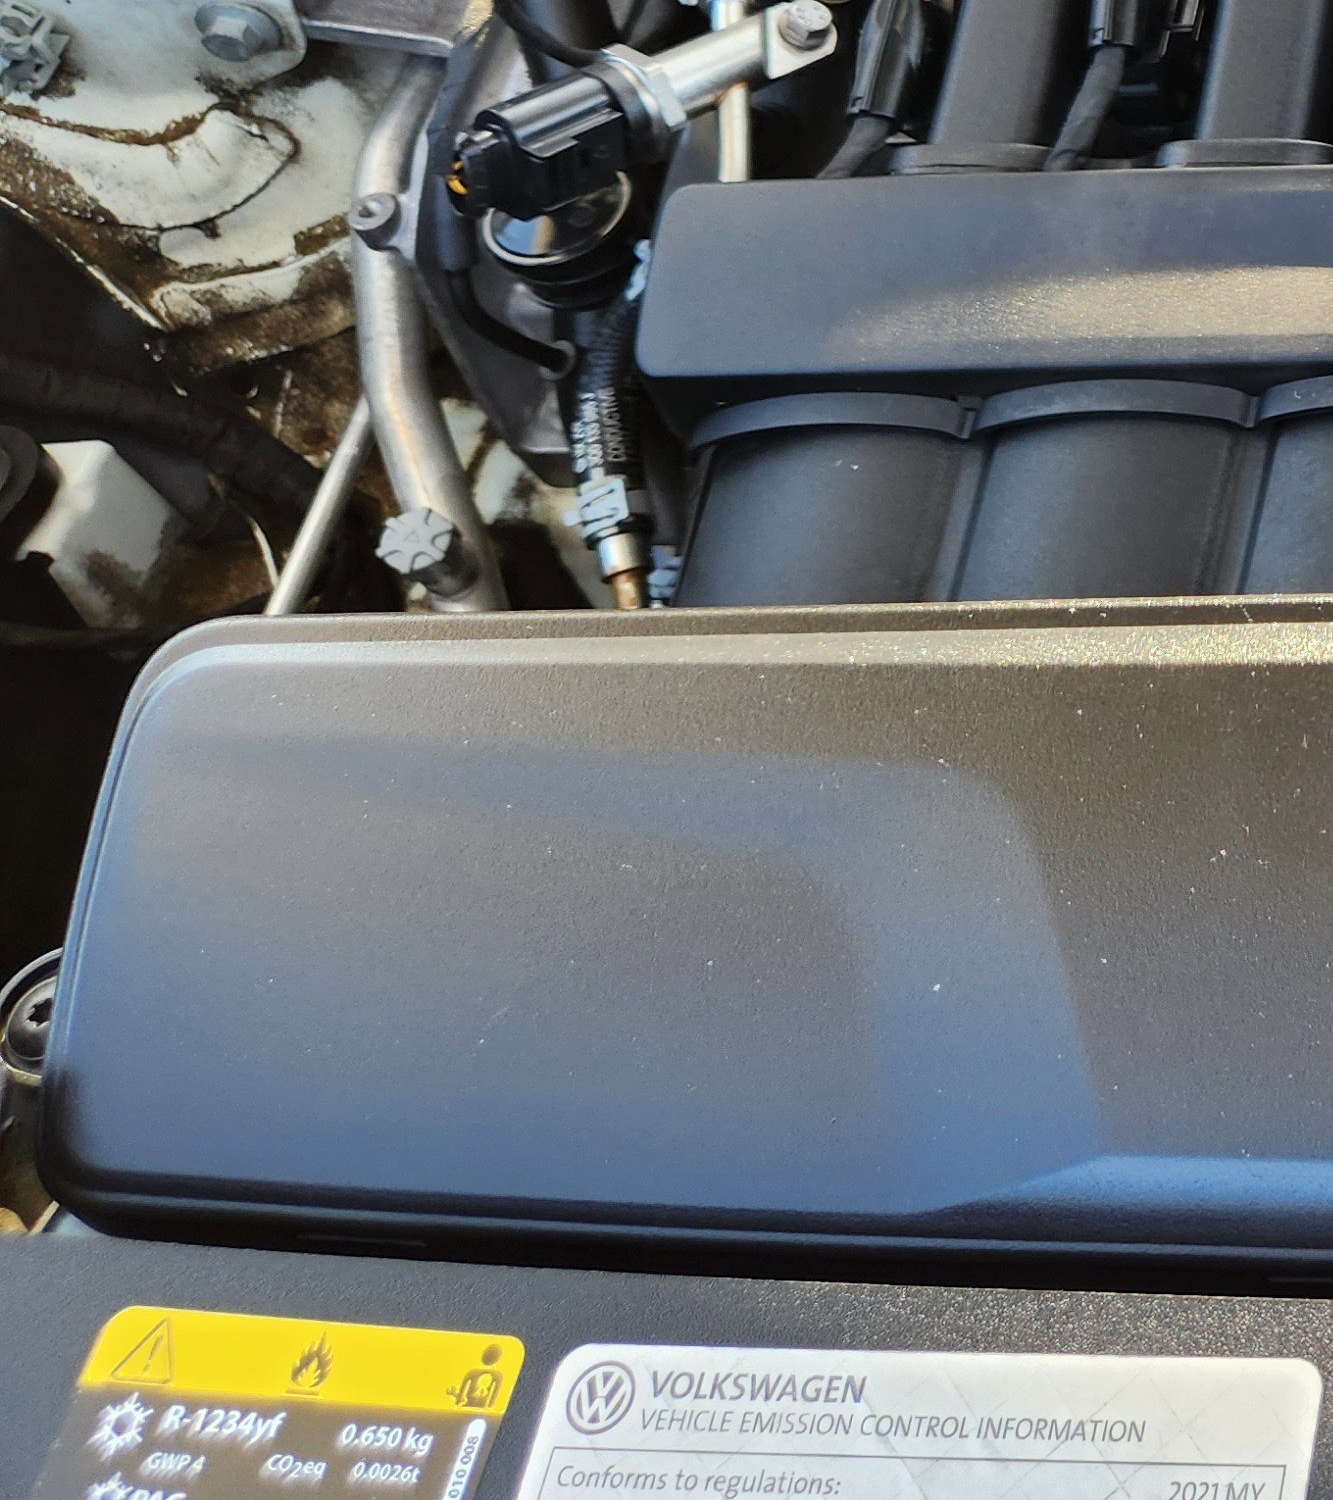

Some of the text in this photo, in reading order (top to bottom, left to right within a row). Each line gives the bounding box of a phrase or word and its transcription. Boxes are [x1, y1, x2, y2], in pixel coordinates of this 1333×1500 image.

[651, 1370, 867, 1403] VOLKSWAGEN
[156, 1404, 288, 1450] R-1234yf
[404, 1426, 434, 1457] kg
[641, 1408, 1146, 1443] VEHICLE EMISSION CONTROL INFORMATION
[144, 1452, 192, 1476] GWP
[352, 1461, 421, 1483] 0.0026t
[557, 1464, 842, 1500] Conforms to regulations:
[1168, 1481, 1265, 1500] 2021 MY
